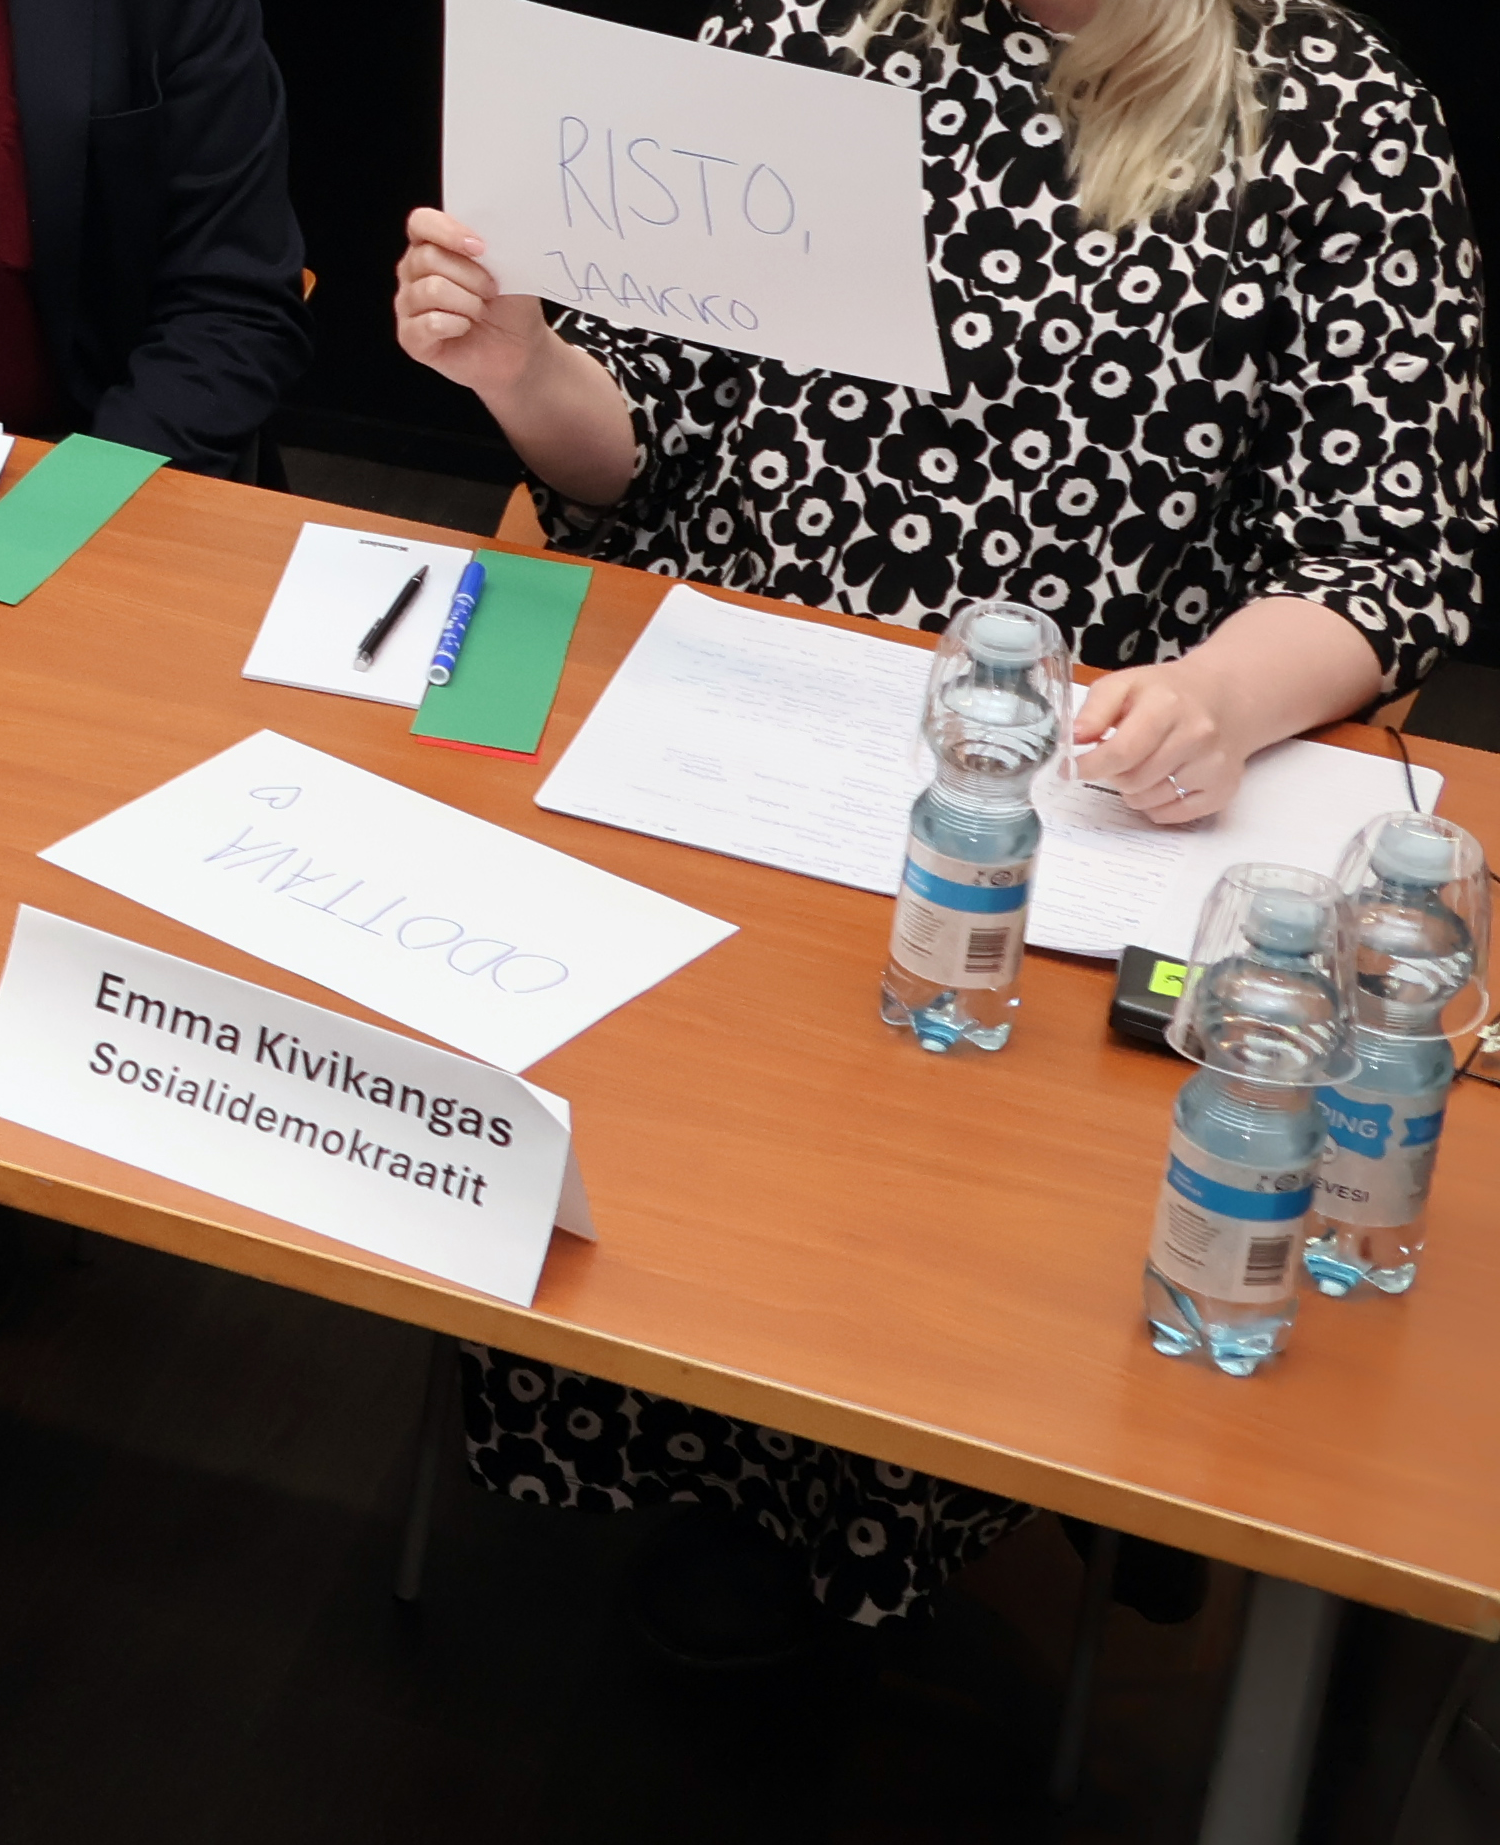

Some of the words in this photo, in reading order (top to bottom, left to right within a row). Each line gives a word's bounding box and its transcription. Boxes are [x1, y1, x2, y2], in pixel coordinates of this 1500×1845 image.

[557, 115, 811, 255] RISTO,
[542, 250, 760, 332] JAAKKO
[201, 827, 570, 993] ODOTTAVA
[88, 1041, 488, 1207] Sosialidemokraatit
[94, 971, 242, 1056] Emma
[254, 1025, 513, 1148] Kivikangas
